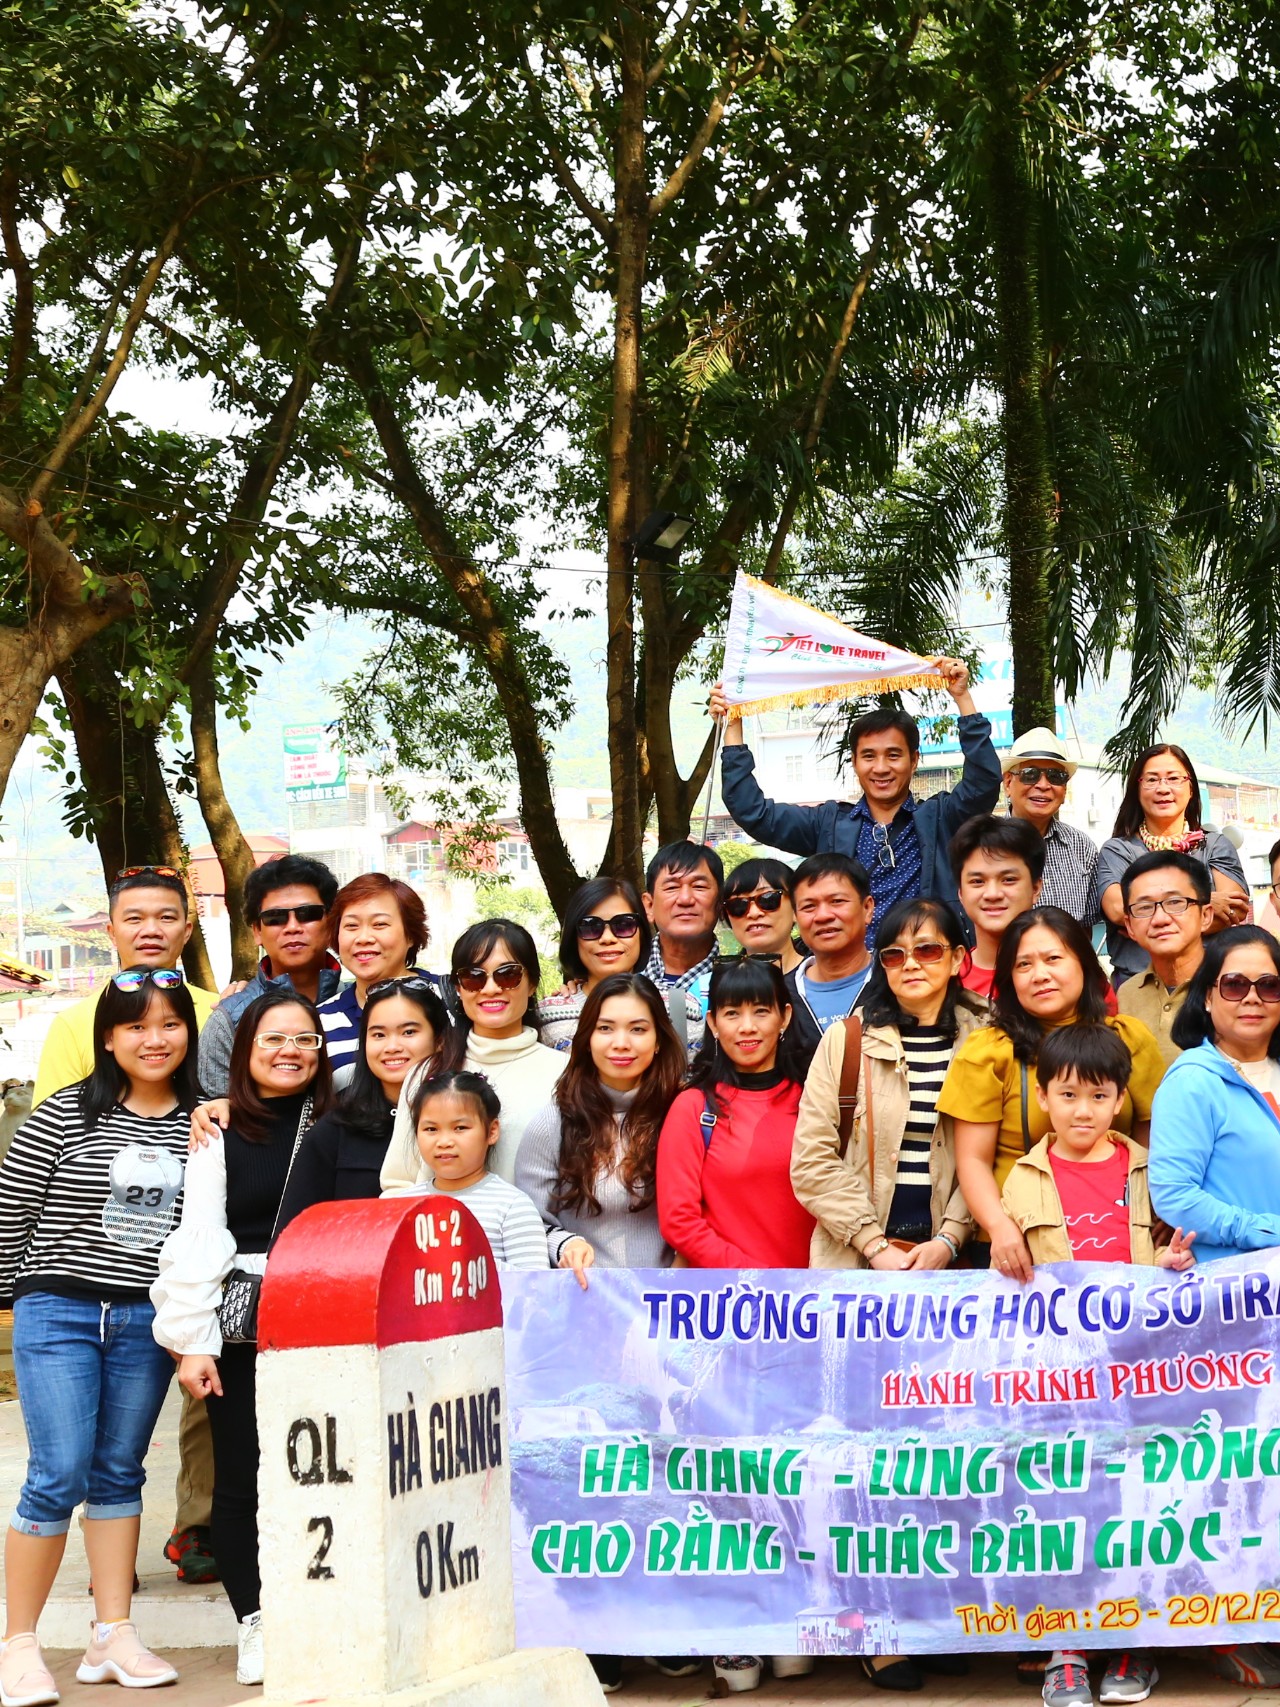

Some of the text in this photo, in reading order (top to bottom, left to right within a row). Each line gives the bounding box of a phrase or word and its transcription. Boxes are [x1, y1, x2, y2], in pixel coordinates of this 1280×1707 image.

[848, 647, 887, 662] TRAVEL
[125, 1185, 164, 1207] 23
[414, 1268, 443, 1306] Km
[643, 1284, 818, 1341] TRƯỜNG
[831, 1292, 980, 1341] TRUNG
[988, 1287, 1069, 1351] HỌC
[1077, 1280, 1136, 1332] CƠ
[1144, 1271, 1205, 1329] SỞ
[882, 1362, 976, 1408] HÀNH
[983, 1366, 1098, 1407] TRÌNH
[1108, 1350, 1271, 1402] PHƯƠNG
[286, 1414, 354, 1487] QL
[387, 1386, 503, 1500] HÀ GIANG
[582, 1434, 650, 1494] HÀ
[666, 1445, 804, 1496] GIANG
[870, 1438, 999, 1496] LŨNG
[1016, 1431, 1094, 1492] CÚ
[306, 1515, 336, 1581] 2
[531, 1522, 631, 1575] CAO
[649, 1505, 782, 1573] BẰNG
[829, 1516, 953, 1575] THÁC
[970, 1509, 1075, 1575] BẢN
[1094, 1499, 1221, 1569] GIỐC
[955, 1603, 1018, 1635] Thời
[1025, 1606, 1078, 1639] gian
[1099, 1599, 1140, 1629] 25
